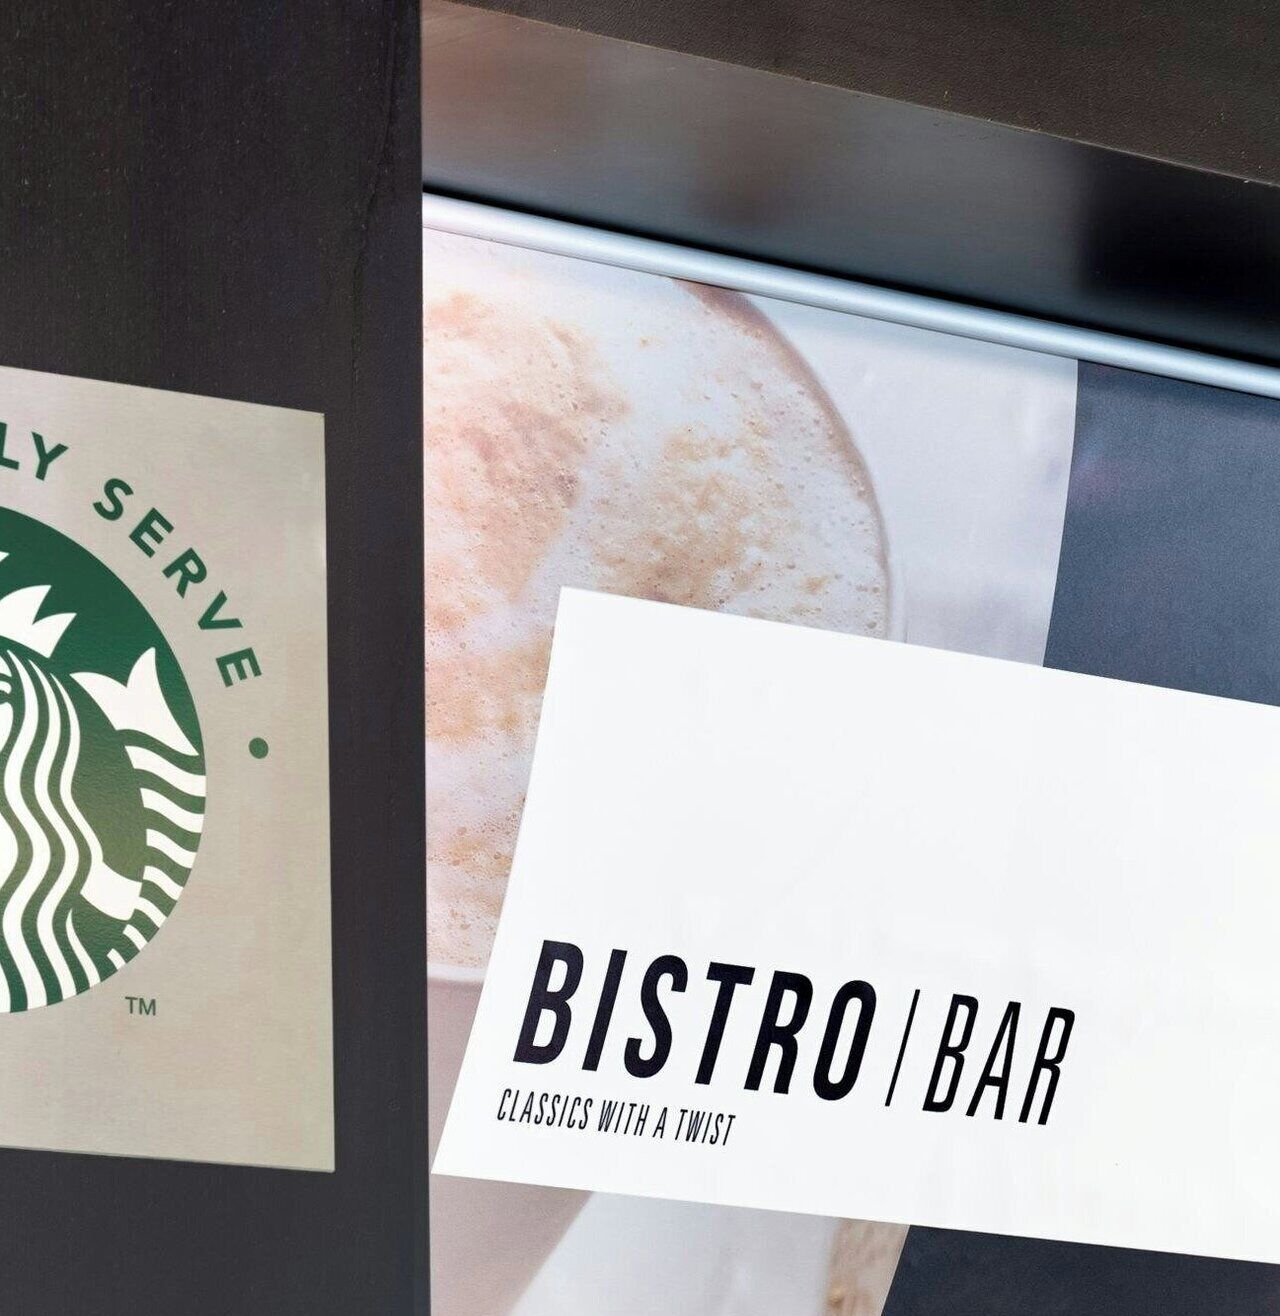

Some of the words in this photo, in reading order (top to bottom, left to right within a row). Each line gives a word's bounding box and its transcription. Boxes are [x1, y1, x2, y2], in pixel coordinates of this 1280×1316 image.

[93, 479, 262, 688] SERVE
[497, 1088, 593, 1130] CLASSICS
[598, 1100, 650, 1136] WITH
[652, 1107, 668, 1139] A
[675, 1109, 736, 1146] TWIST
[513, 939, 877, 1102] BISTRO
[923, 993, 1076, 1126] BAR
